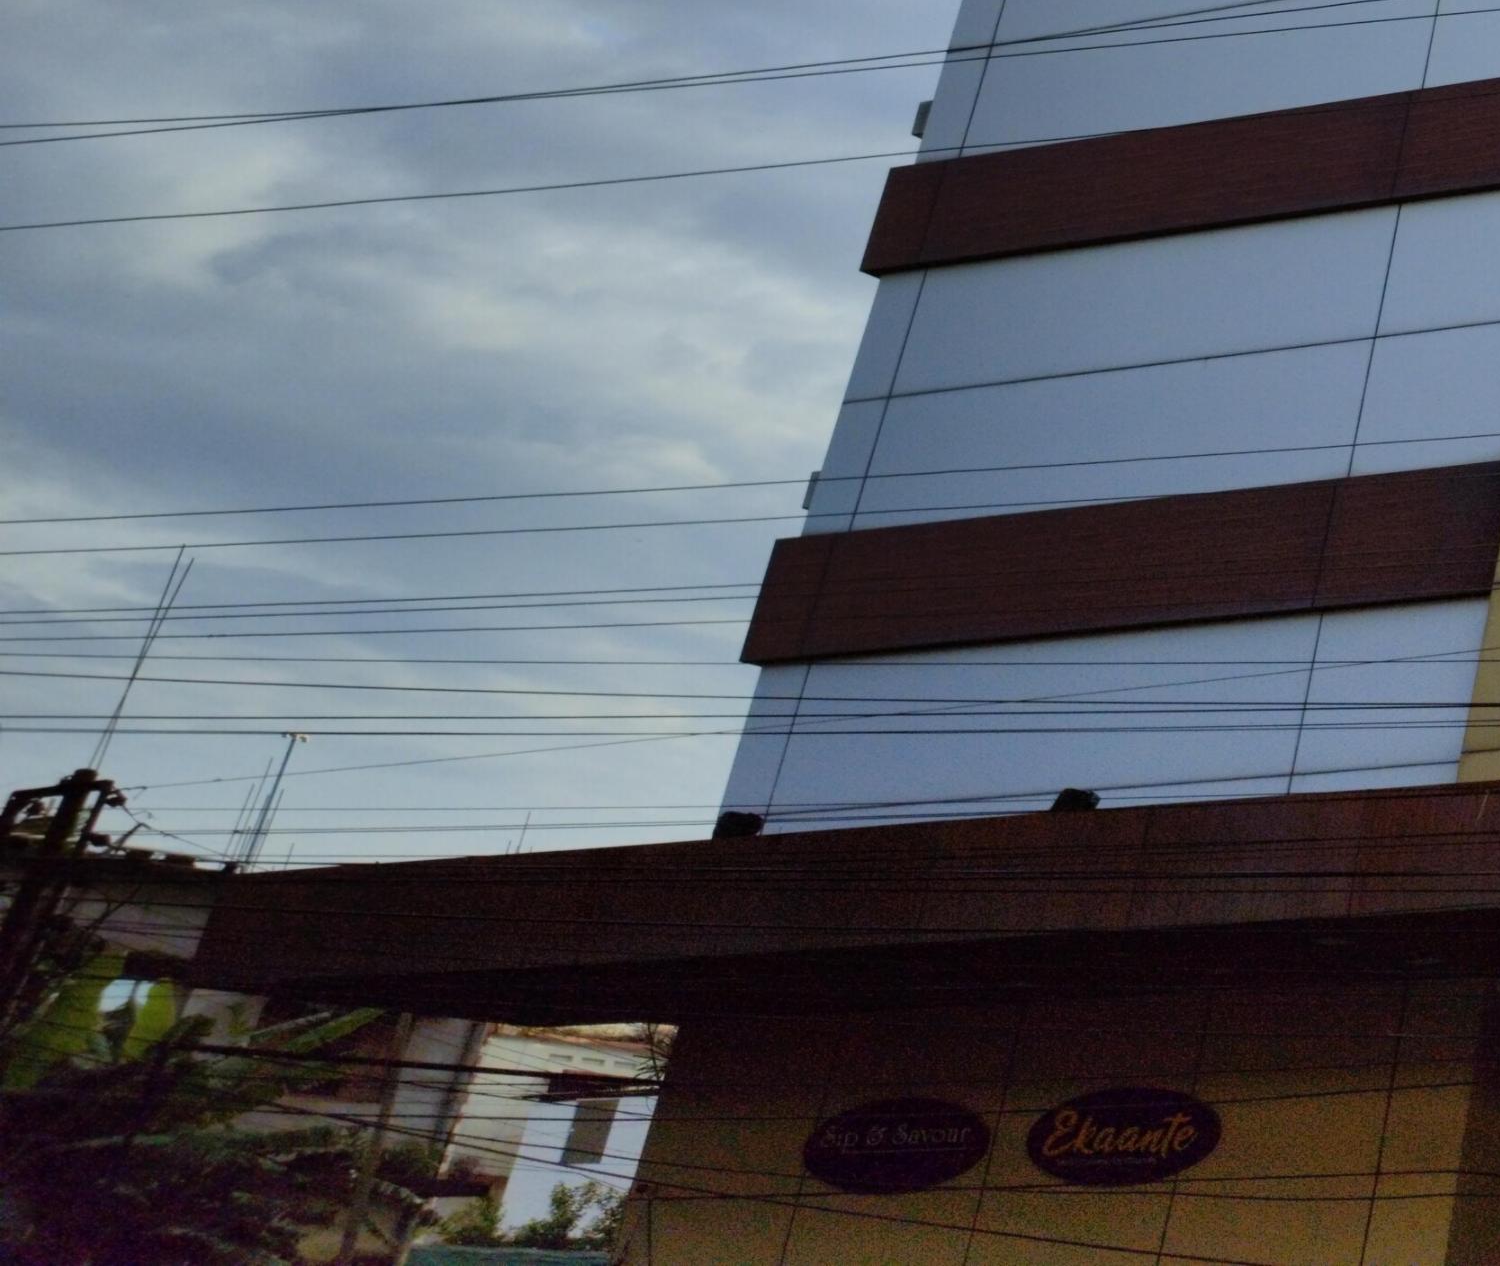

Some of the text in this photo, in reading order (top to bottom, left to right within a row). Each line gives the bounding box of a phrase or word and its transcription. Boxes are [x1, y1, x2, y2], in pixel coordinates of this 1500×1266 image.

[819, 1125, 859, 1153] Sip
[891, 1123, 971, 1146] Savour
[1042, 1109, 1198, 1159] Ekaante
